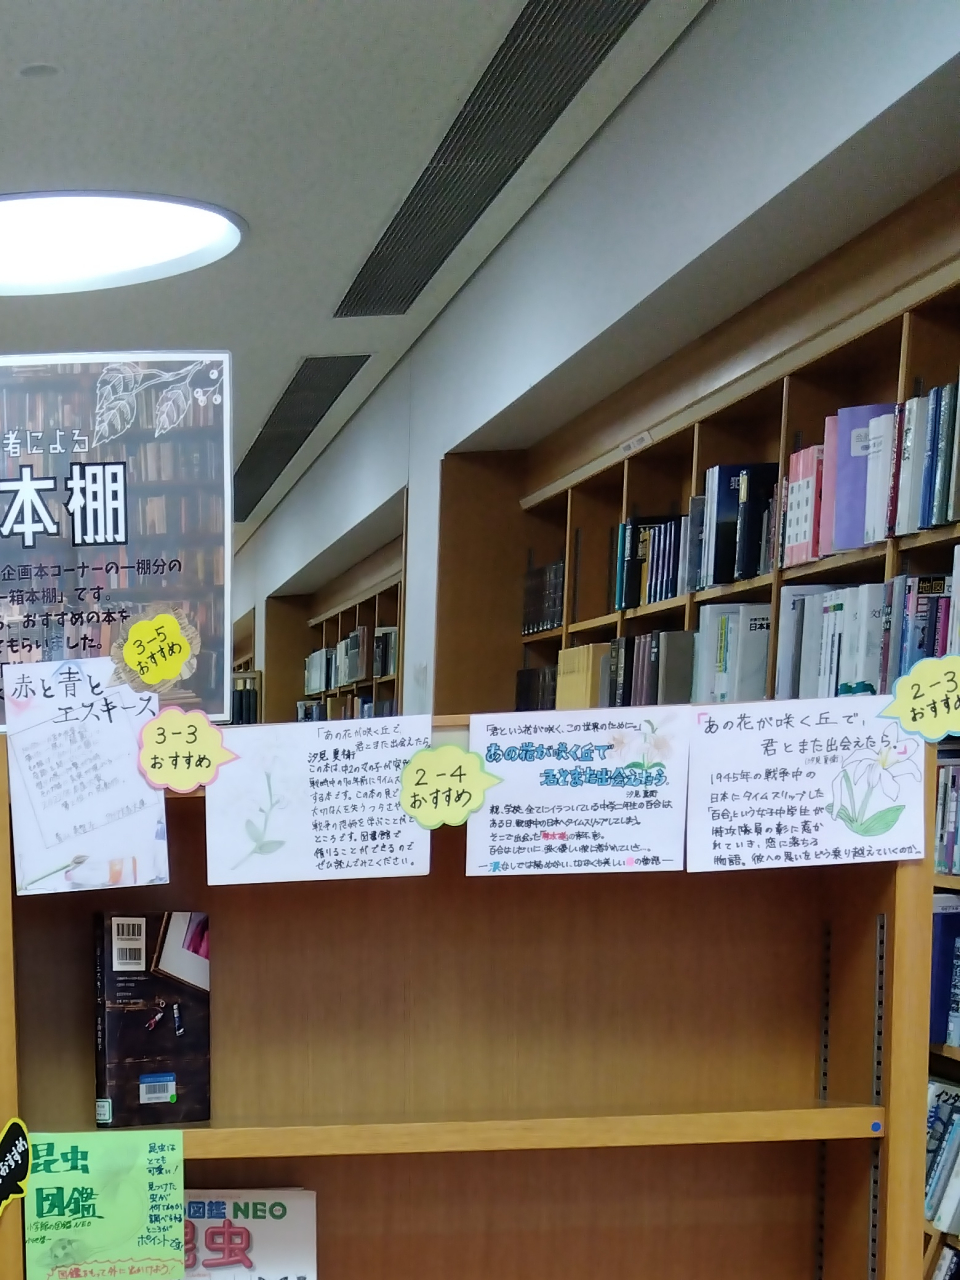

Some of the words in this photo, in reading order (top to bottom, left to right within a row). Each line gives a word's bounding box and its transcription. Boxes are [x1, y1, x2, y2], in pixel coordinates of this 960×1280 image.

[133, 625, 168, 656] 3-5
[136, 641, 183, 677] おすすめ
[11, 666, 105, 700] 赤と青と
[53, 694, 158, 725] エスキース
[155, 723, 198, 745] 3-3
[150, 751, 212, 770] おすすめ
[485, 742, 614, 763] あの花が咲く丘で
[415, 765, 467, 787] 2-4
[540, 766, 670, 788] 君とまた出会えたら。
[710, 768, 817, 786] 1945年の戦争中の
[410, 788, 473, 810] おすすめ
[710, 788, 825, 804] 日本にタイムスリップした
[707, 805, 825, 823] 「百合」という女子中学生が
[315, 856, 416, 871] ぜひ読んでみてください。
[30, 1142, 90, 1175] 昆虫
[148, 1143, 176, 1155] 昆虫は
[147, 1156, 167, 1165] とても
[146, 1165, 179, 1176] 可愛い!
[147, 1181, 177, 1193] 見つけた
[35, 1186, 104, 1221] 図鑑
[148, 1193, 171, 1203] 虫が
[232, 1201, 288, 1221] NEO
[137, 1233, 184, 1252] ポイントです!
[57, 1265, 176, 1280] 図鑑をもって外に出かけよう!
